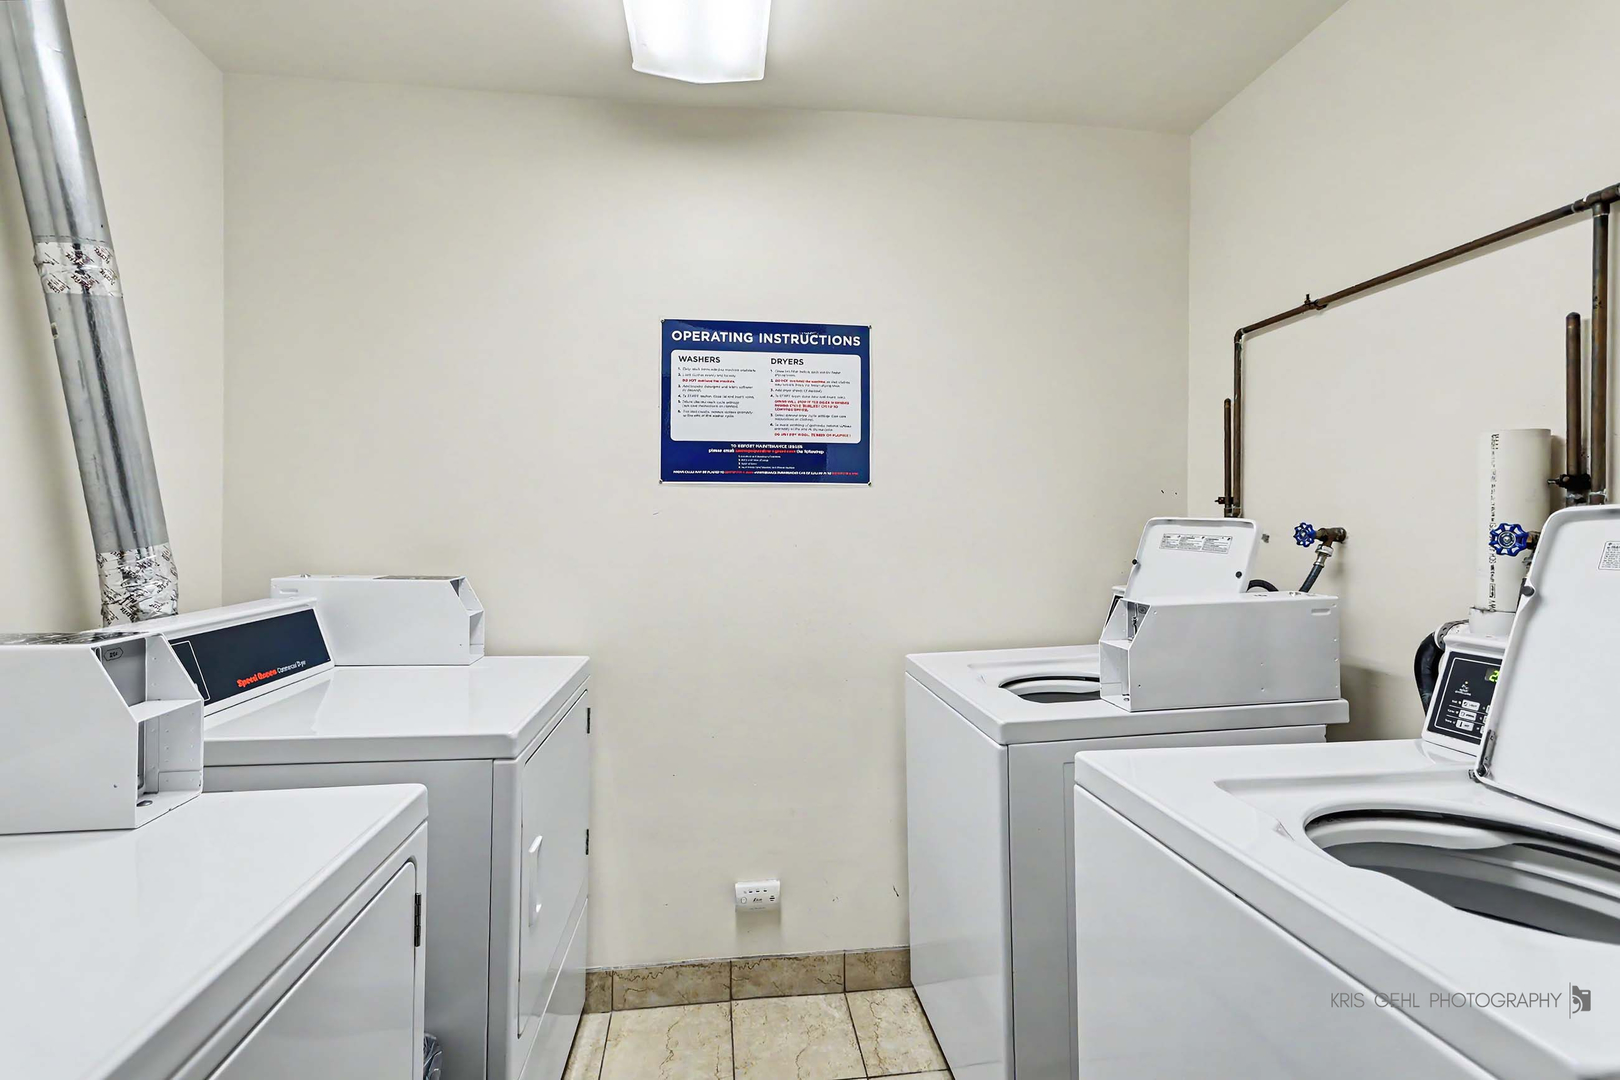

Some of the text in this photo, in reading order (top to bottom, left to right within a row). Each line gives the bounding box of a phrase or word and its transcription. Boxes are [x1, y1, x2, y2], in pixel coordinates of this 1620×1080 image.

[671, 330, 861, 346] OPERATING INSTRUCTIONS
[678, 355, 721, 363] WASHERS
[770, 358, 804, 366] DRYERS
[236, 674, 258, 688] Speed
